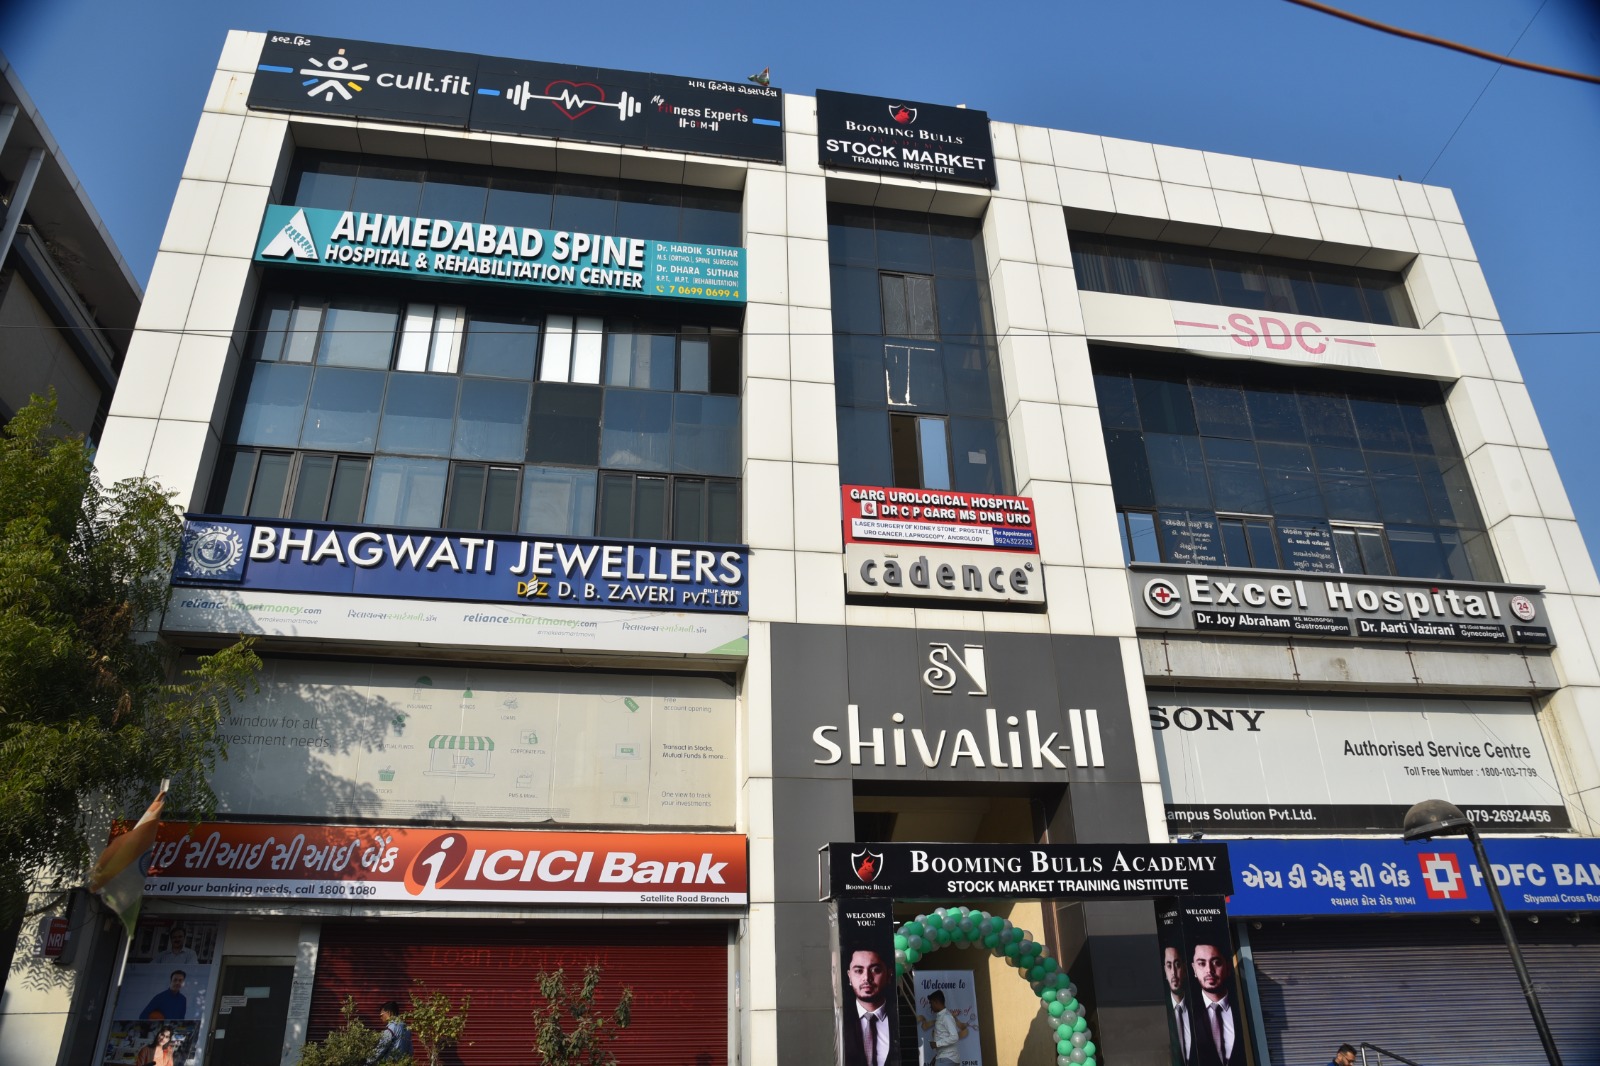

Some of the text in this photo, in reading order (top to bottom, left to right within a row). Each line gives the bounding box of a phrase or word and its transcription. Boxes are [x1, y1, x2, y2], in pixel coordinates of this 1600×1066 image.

[376, 72, 471, 95] cult.fit
[688, 80, 706, 89] માય
[650, 95, 665, 106] My
[704, 108, 749, 122] Experts
[845, 120, 914, 138] BOOMING
[826, 139, 986, 171] STOCK MARKET
[852, 155, 955, 175] TRAINING INSTITUTE
[330, 211, 646, 269] AHMEDABAD SPINE
[656, 243, 739, 258] Dr. HARDIK SUTHAR
[324, 244, 644, 289] HOSPITAL & REHABILITATION CENTER
[712, 258, 739, 267] SURGEON
[656, 264, 739, 278] Dr. DHARA SUTHAR
[669, 285, 739, 298] 7 0699 0699 4
[1227, 313, 1327, 355] SDC
[850, 488, 1030, 511] GARG UROLOGICAL HOSPITAL
[881, 504, 1031, 524] DR C P GARG MS DNB URO
[876, 521, 904, 530] SURGERY
[913, 524, 936, 532] KIDNEY
[959, 527, 991, 535] PROSTATE,
[948, 534, 983, 542] ANDROLOGY
[250, 526, 742, 585] BHAGWATI JEWELLERS
[558, 581, 710, 604] D. B. ZAVERI PVT.
[1186, 574, 1309, 609] Excel
[1324, 581, 1502, 619] Hospital
[1516, 602, 1529, 611] 24
[463, 612, 598, 629] reliancesmartmoney.com
[1196, 612, 1291, 628] Dr. Joy Abraham
[1294, 621, 1349, 632] Gastrosurgeon
[1360, 620, 1456, 636] Dr. Aarti Vazirani
[1461, 629, 1506, 639] Gynecologist
[688, 706, 712, 714] opening
[229, 714, 275, 728] window
[280, 715, 300, 729] for
[302, 717, 319, 730] all
[1148, 706, 1265, 731] SONY
[662, 743, 687, 751] Transact
[1343, 739, 1532, 759] Authorised Service Centre
[1403, 766, 1538, 778] Toll Free Number 1800-103-7799
[689, 790, 696, 798] to
[1213, 808, 1317, 821] Solution Pvt.Ltd.
[1466, 809, 1551, 823] 079-26924456
[361, 835, 400, 873] બેંક
[909, 850, 1217, 873] BOOMING BULLS ACADEMY
[464, 849, 729, 884] ICICI Bank
[1241, 862, 1411, 891] એચ ડી એફ સી બેંક
[159, 881, 377, 896] all your banking needs, call 1800 1080
[947, 878, 1189, 893] STOCK MARKET TRAINING INSTITUTE
[640, 894, 730, 903] Satellite Road Branch
[1330, 897, 1359, 907] શ્યામલ
[1379, 894, 1393, 906] રોડ
[1394, 896, 1416, 906] શાખા
[1523, 893, 1586, 905] Shyamal Cross
[845, 911, 886, 919] WELCOMES
[47, 933, 65, 947] NRI
[920, 978, 966, 990] Welcome to
